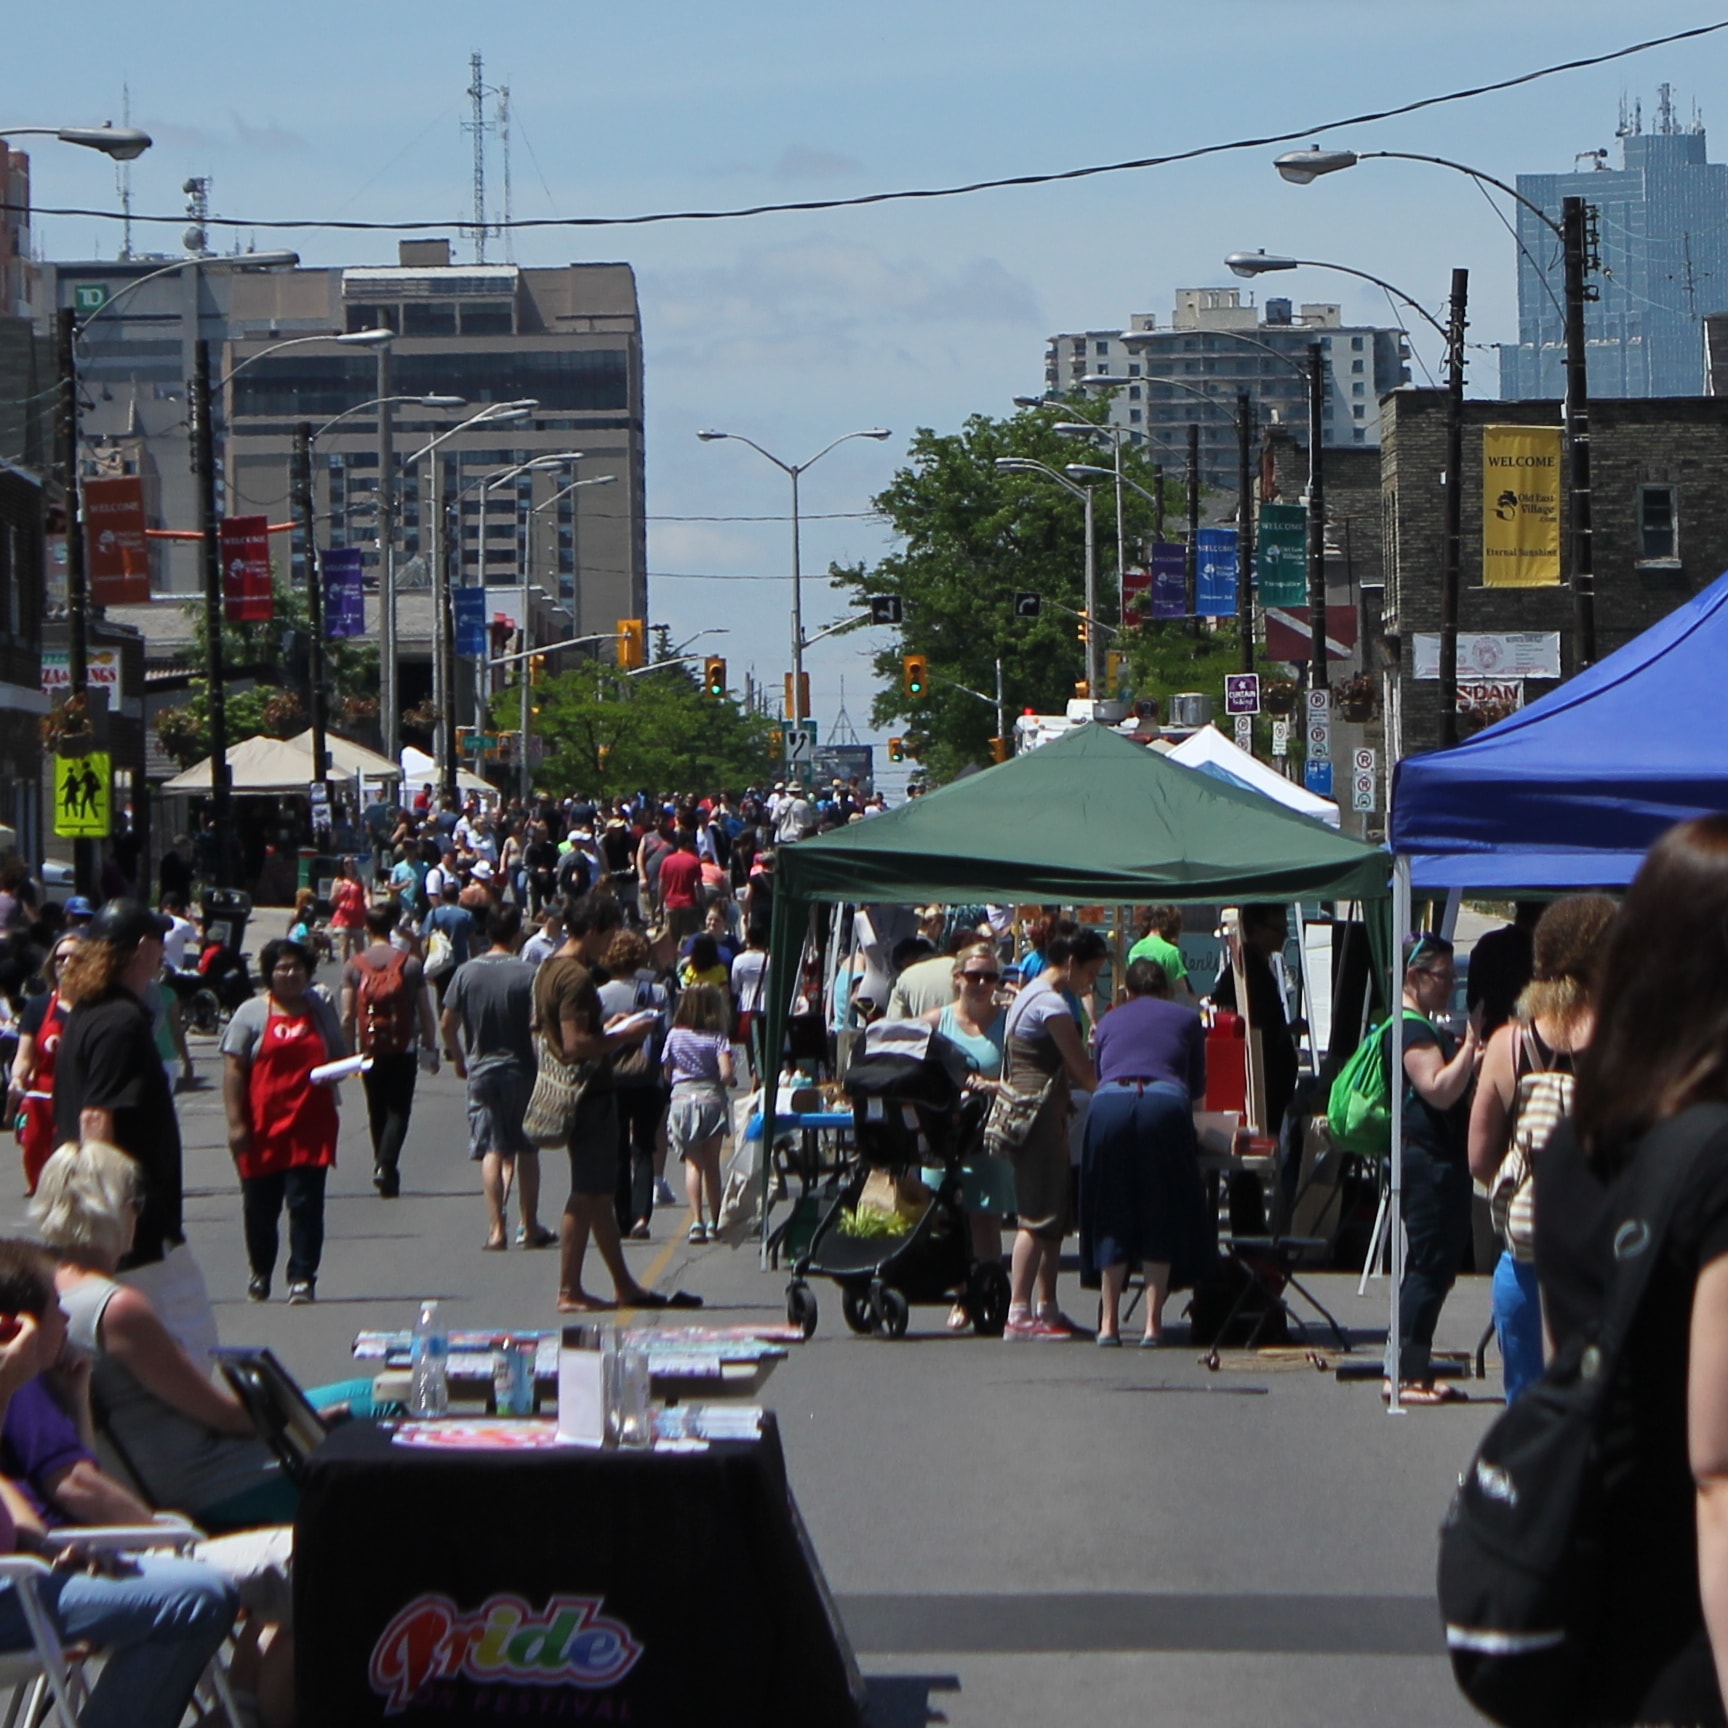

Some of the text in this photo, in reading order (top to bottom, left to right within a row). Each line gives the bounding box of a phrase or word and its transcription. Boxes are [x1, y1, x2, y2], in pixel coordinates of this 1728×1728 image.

[78, 288, 103, 306] TD
[1488, 456, 1555, 468] WELCOME
[1535, 493, 1554, 502] East
[1521, 504, 1555, 515] Village
[371, 1595, 643, 1715] Pride
